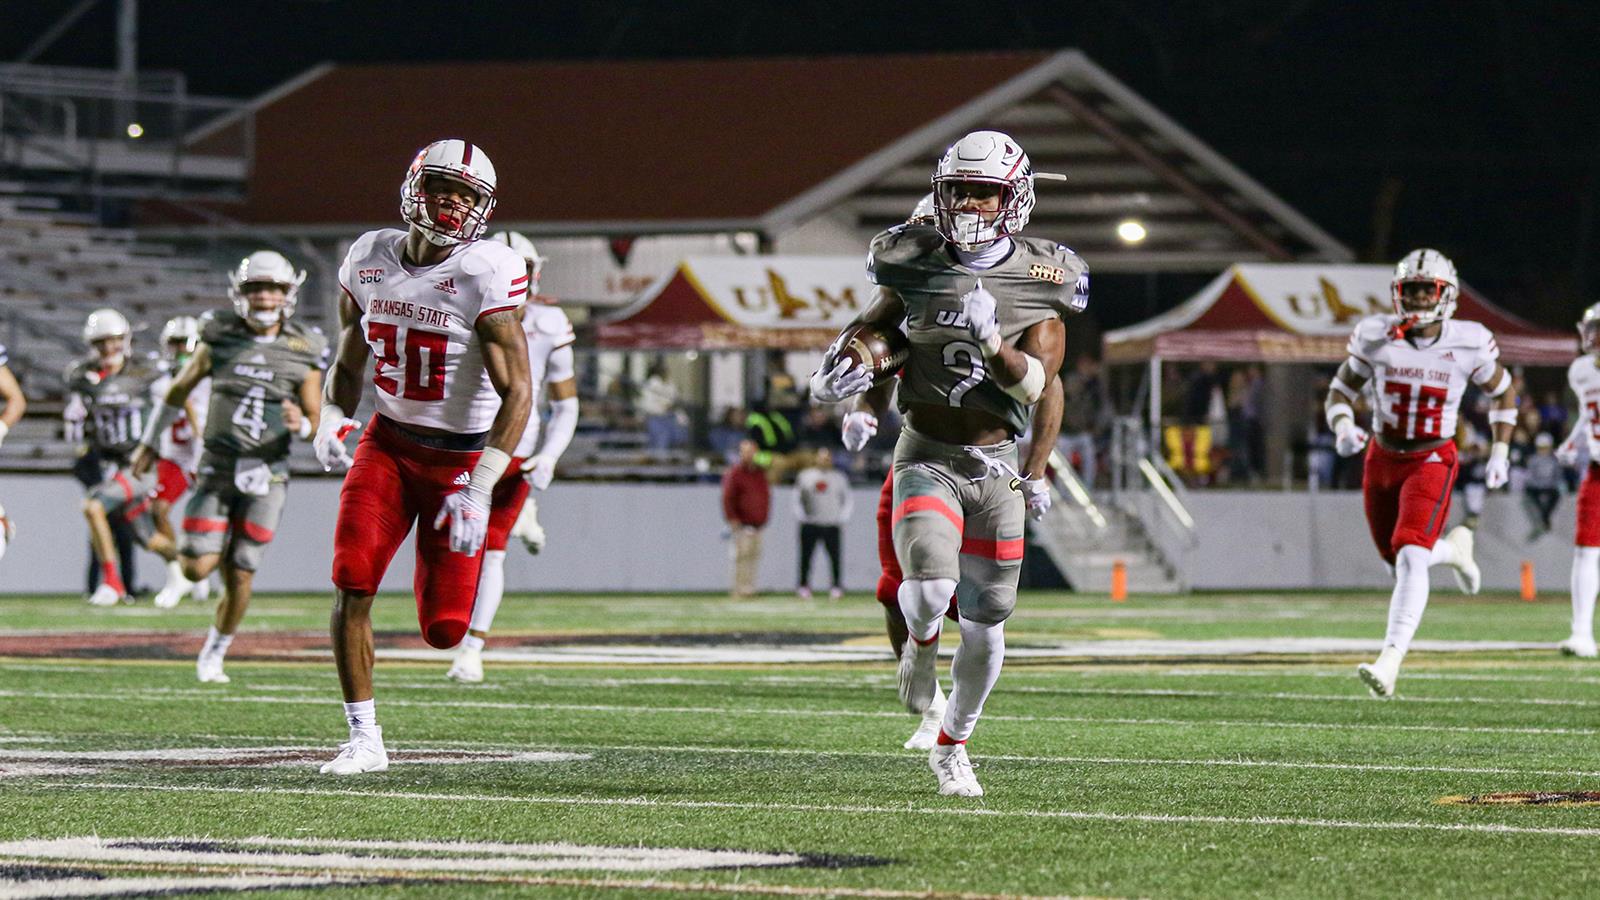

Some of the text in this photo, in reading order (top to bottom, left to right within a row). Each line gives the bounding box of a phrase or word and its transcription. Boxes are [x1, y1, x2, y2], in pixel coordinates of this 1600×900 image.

[417, 306, 451, 328] STATE
[935, 309, 972, 330] UL
[368, 321, 449, 402] 20
[942, 340, 986, 408] 2
[232, 386, 268, 441] 4
[1383, 380, 1448, 440] 38
